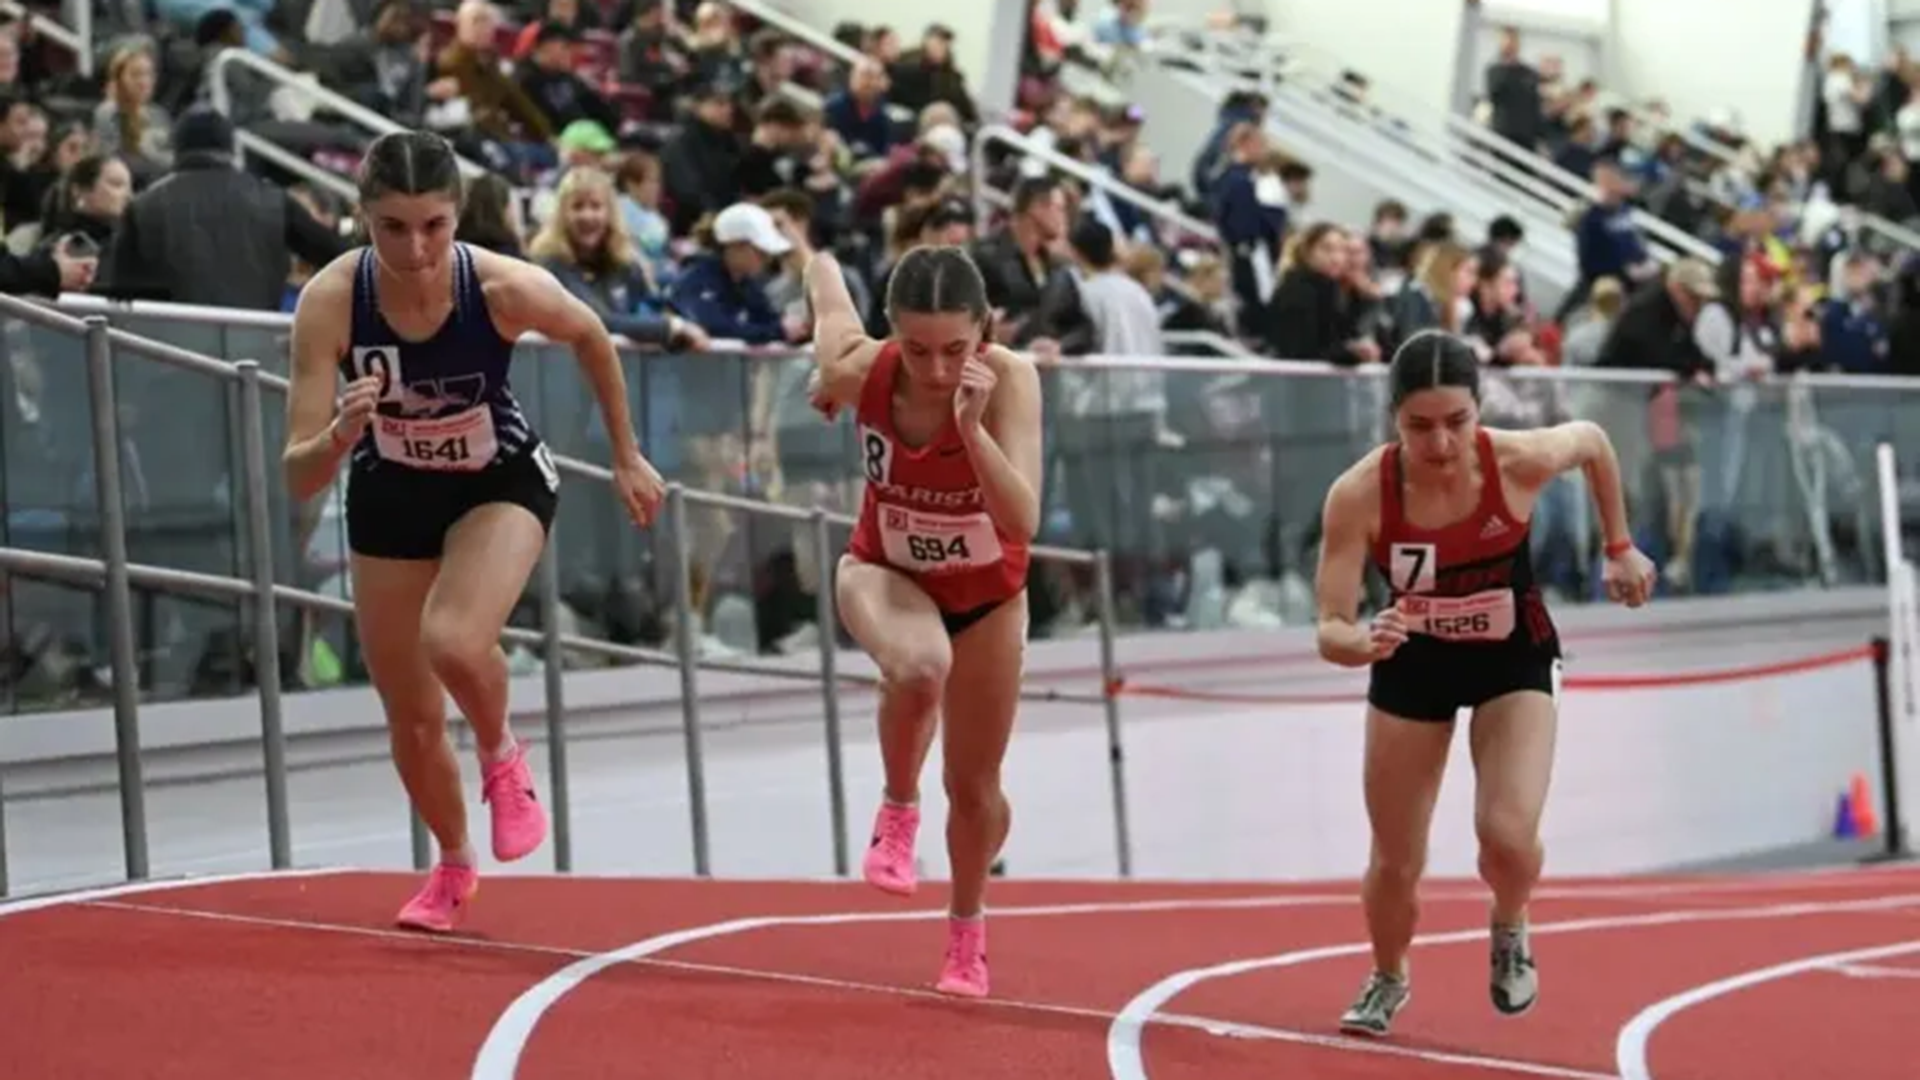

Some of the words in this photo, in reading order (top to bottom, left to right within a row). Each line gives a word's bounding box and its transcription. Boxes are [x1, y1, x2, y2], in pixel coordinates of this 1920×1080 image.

[402, 435, 470, 462] 1641
[865, 433, 886, 484] 8
[883, 484, 984, 508] ARIST
[907, 534, 971, 562] 694
[1401, 548, 1427, 591] 7
[1424, 613, 1490, 635] 1526
